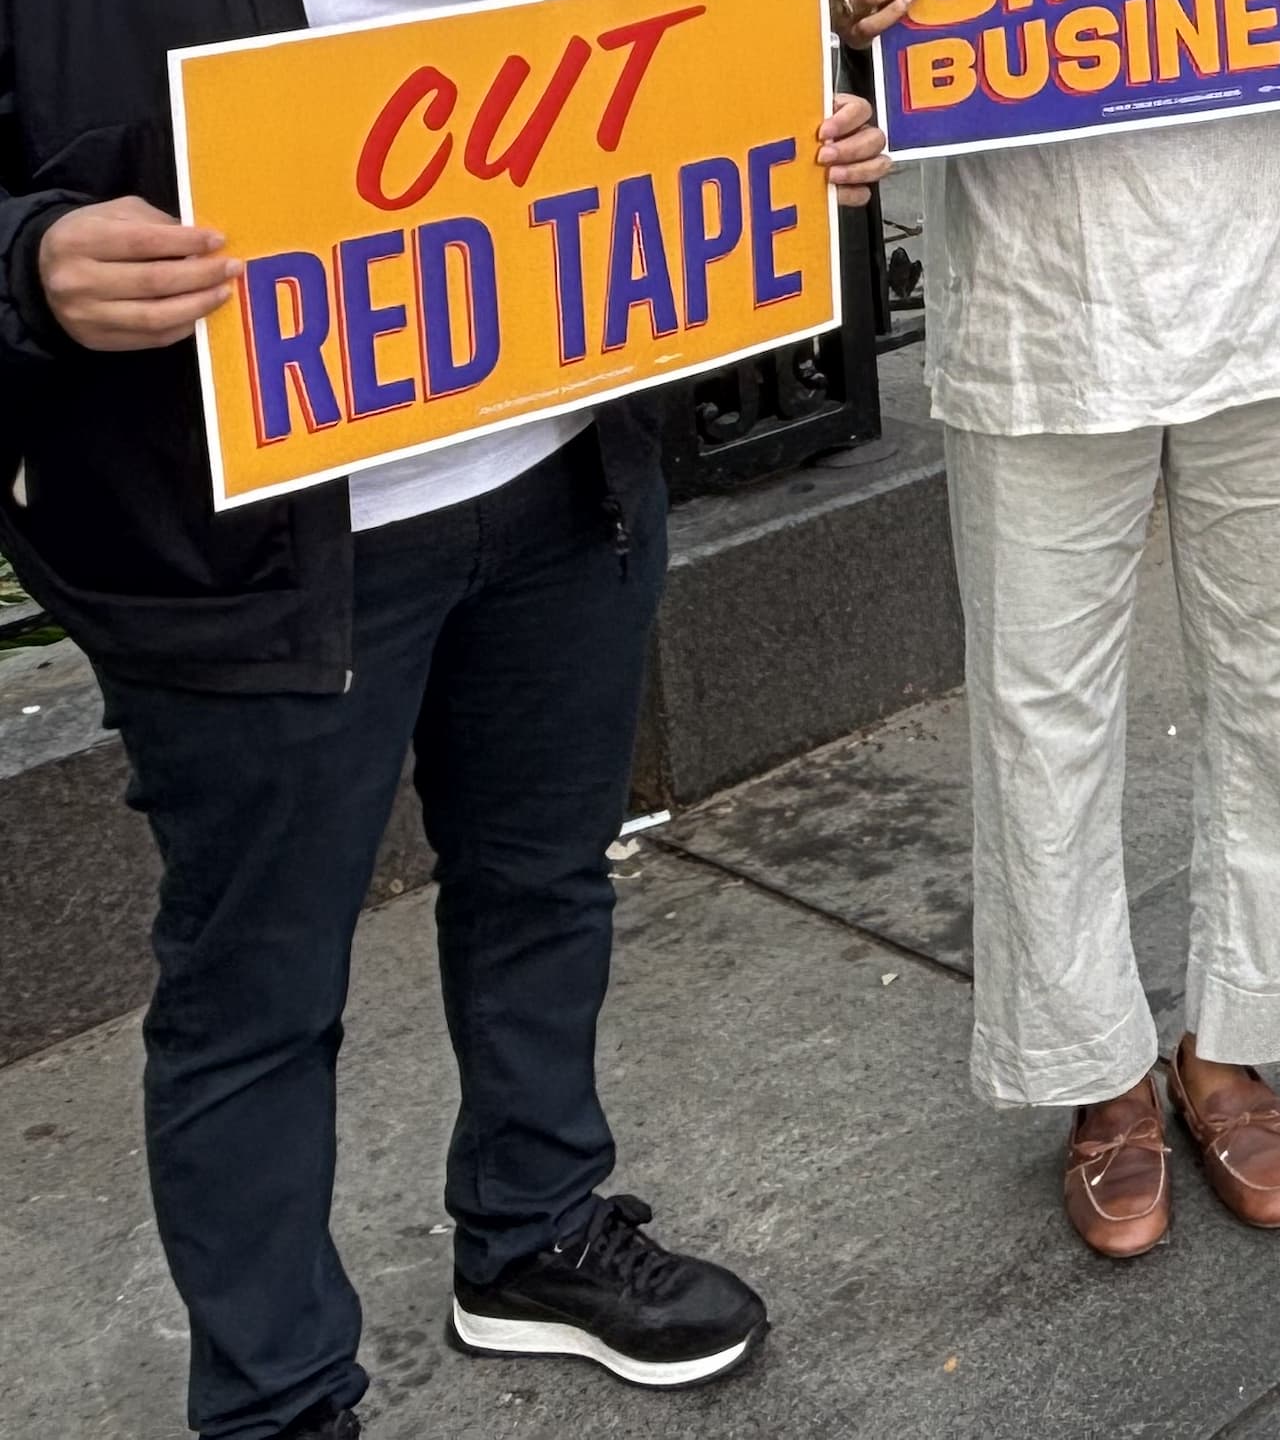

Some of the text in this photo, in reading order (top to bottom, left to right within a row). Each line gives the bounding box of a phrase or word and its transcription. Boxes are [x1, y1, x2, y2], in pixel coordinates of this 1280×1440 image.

[356, 5, 707, 212] CUT
[238, 138, 802, 449] RED TAPE
